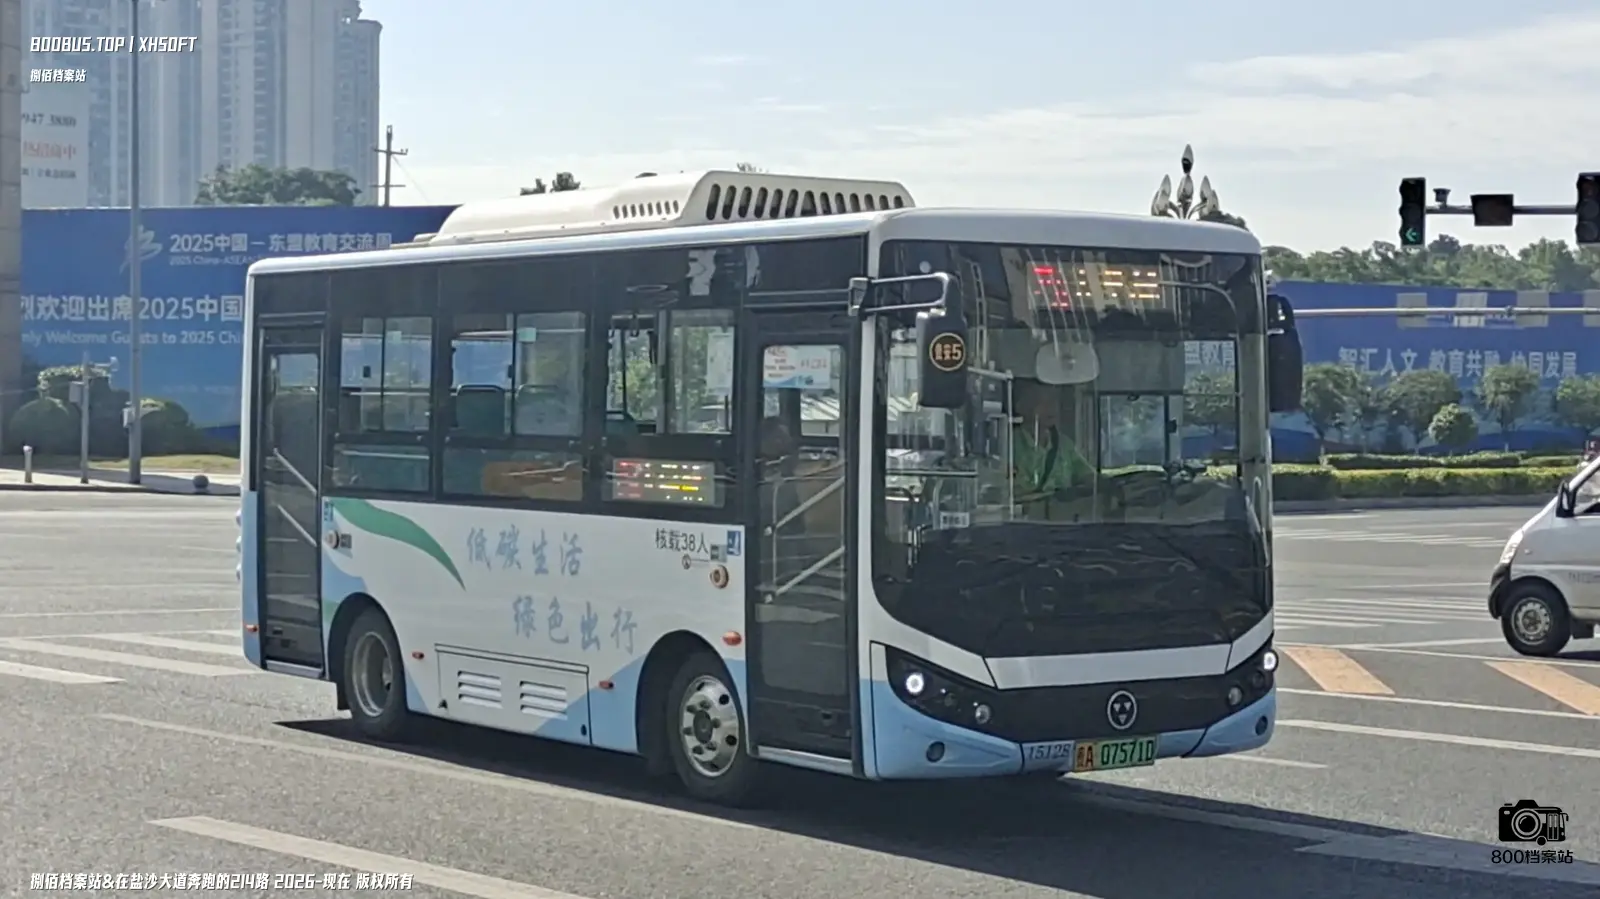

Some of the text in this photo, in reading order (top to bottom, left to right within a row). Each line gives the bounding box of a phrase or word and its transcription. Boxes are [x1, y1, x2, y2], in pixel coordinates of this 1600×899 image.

[112, 330, 159, 344] Gusts
[162, 331, 177, 344] to
[181, 330, 216, 344] 2025
[466, 523, 584, 576] 低碳生活
[655, 527, 709, 554] 核载38人
[512, 595, 638, 655] 绿色出行
